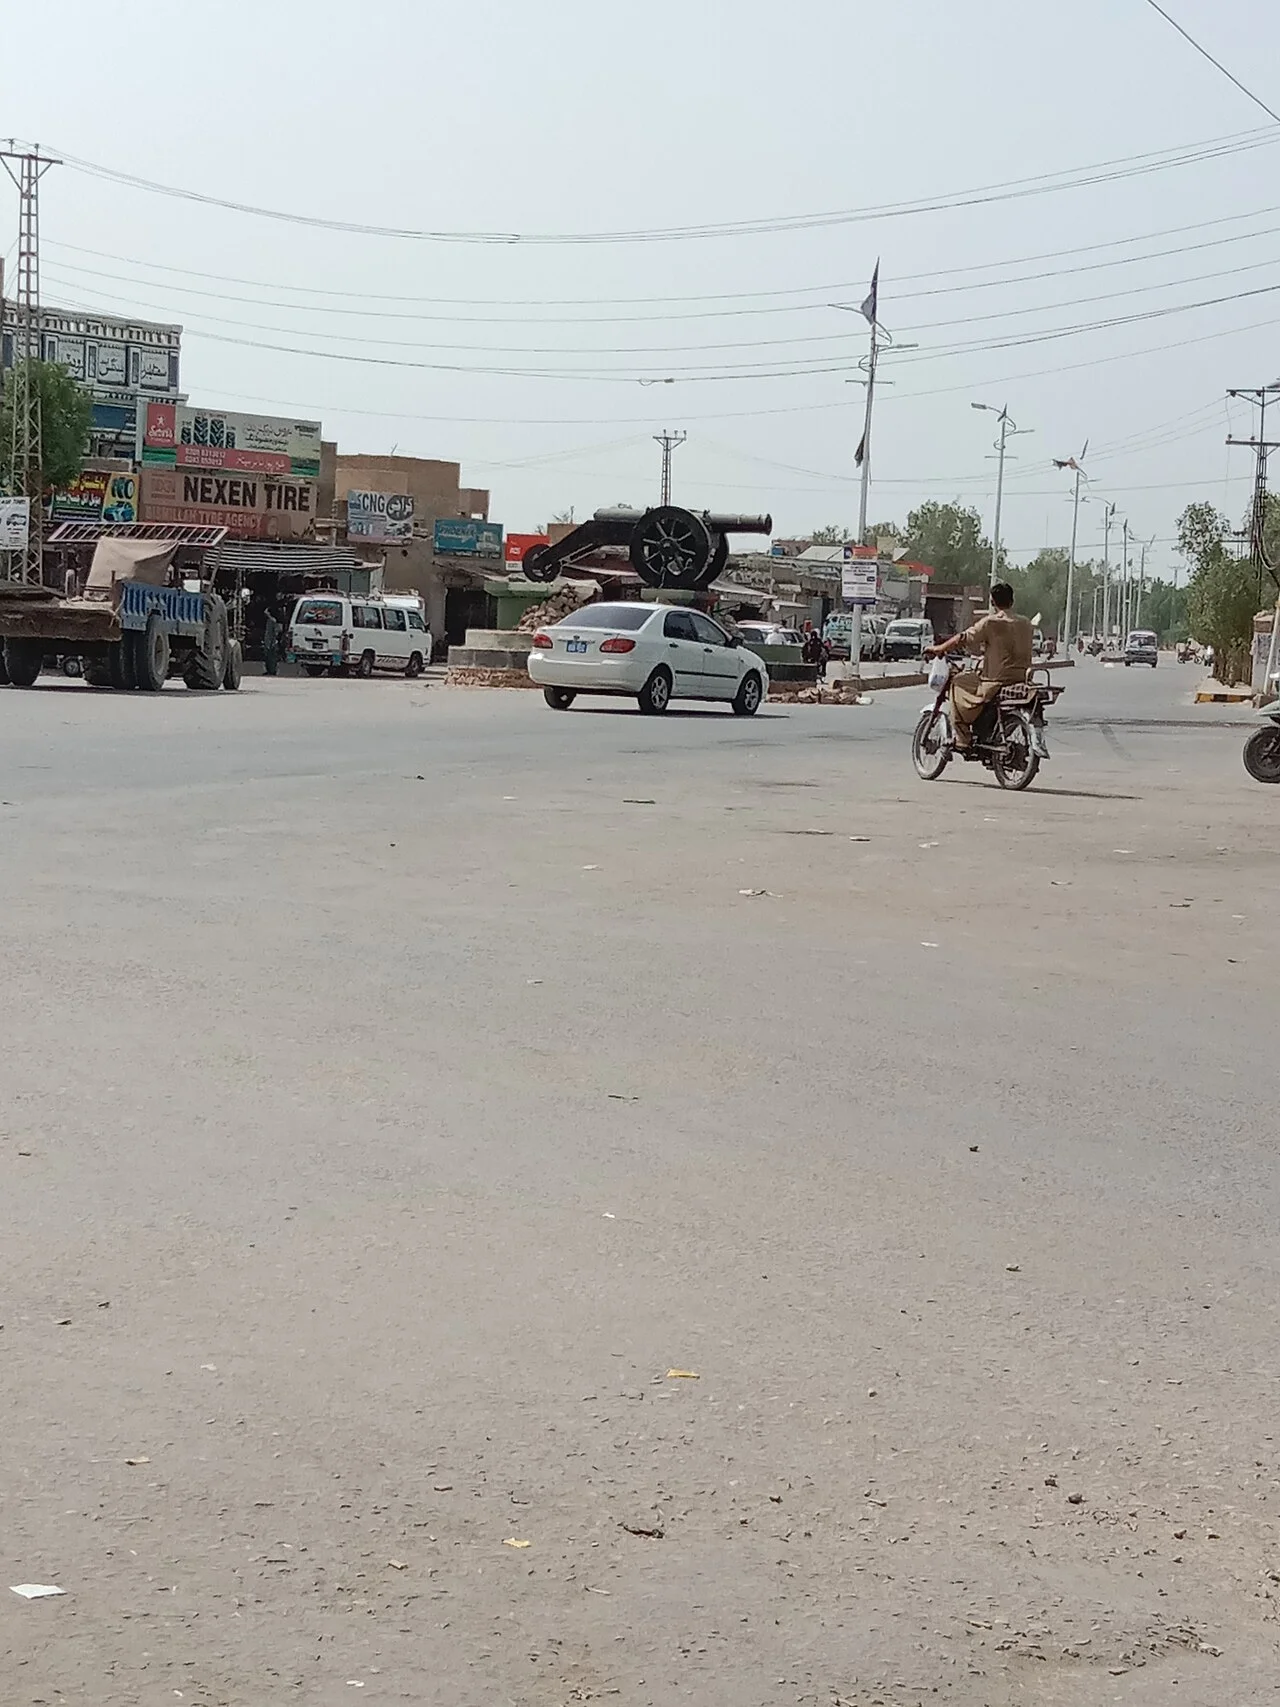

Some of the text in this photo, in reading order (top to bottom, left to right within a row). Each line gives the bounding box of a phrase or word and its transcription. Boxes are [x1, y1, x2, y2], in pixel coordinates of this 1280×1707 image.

[183, 476, 257, 508] NEXEN
[264, 483, 310, 512] TIRE
[362, 493, 386, 513] CNG
[200, 510, 223, 525] TYRE
[225, 513, 262, 529] AGENCY
